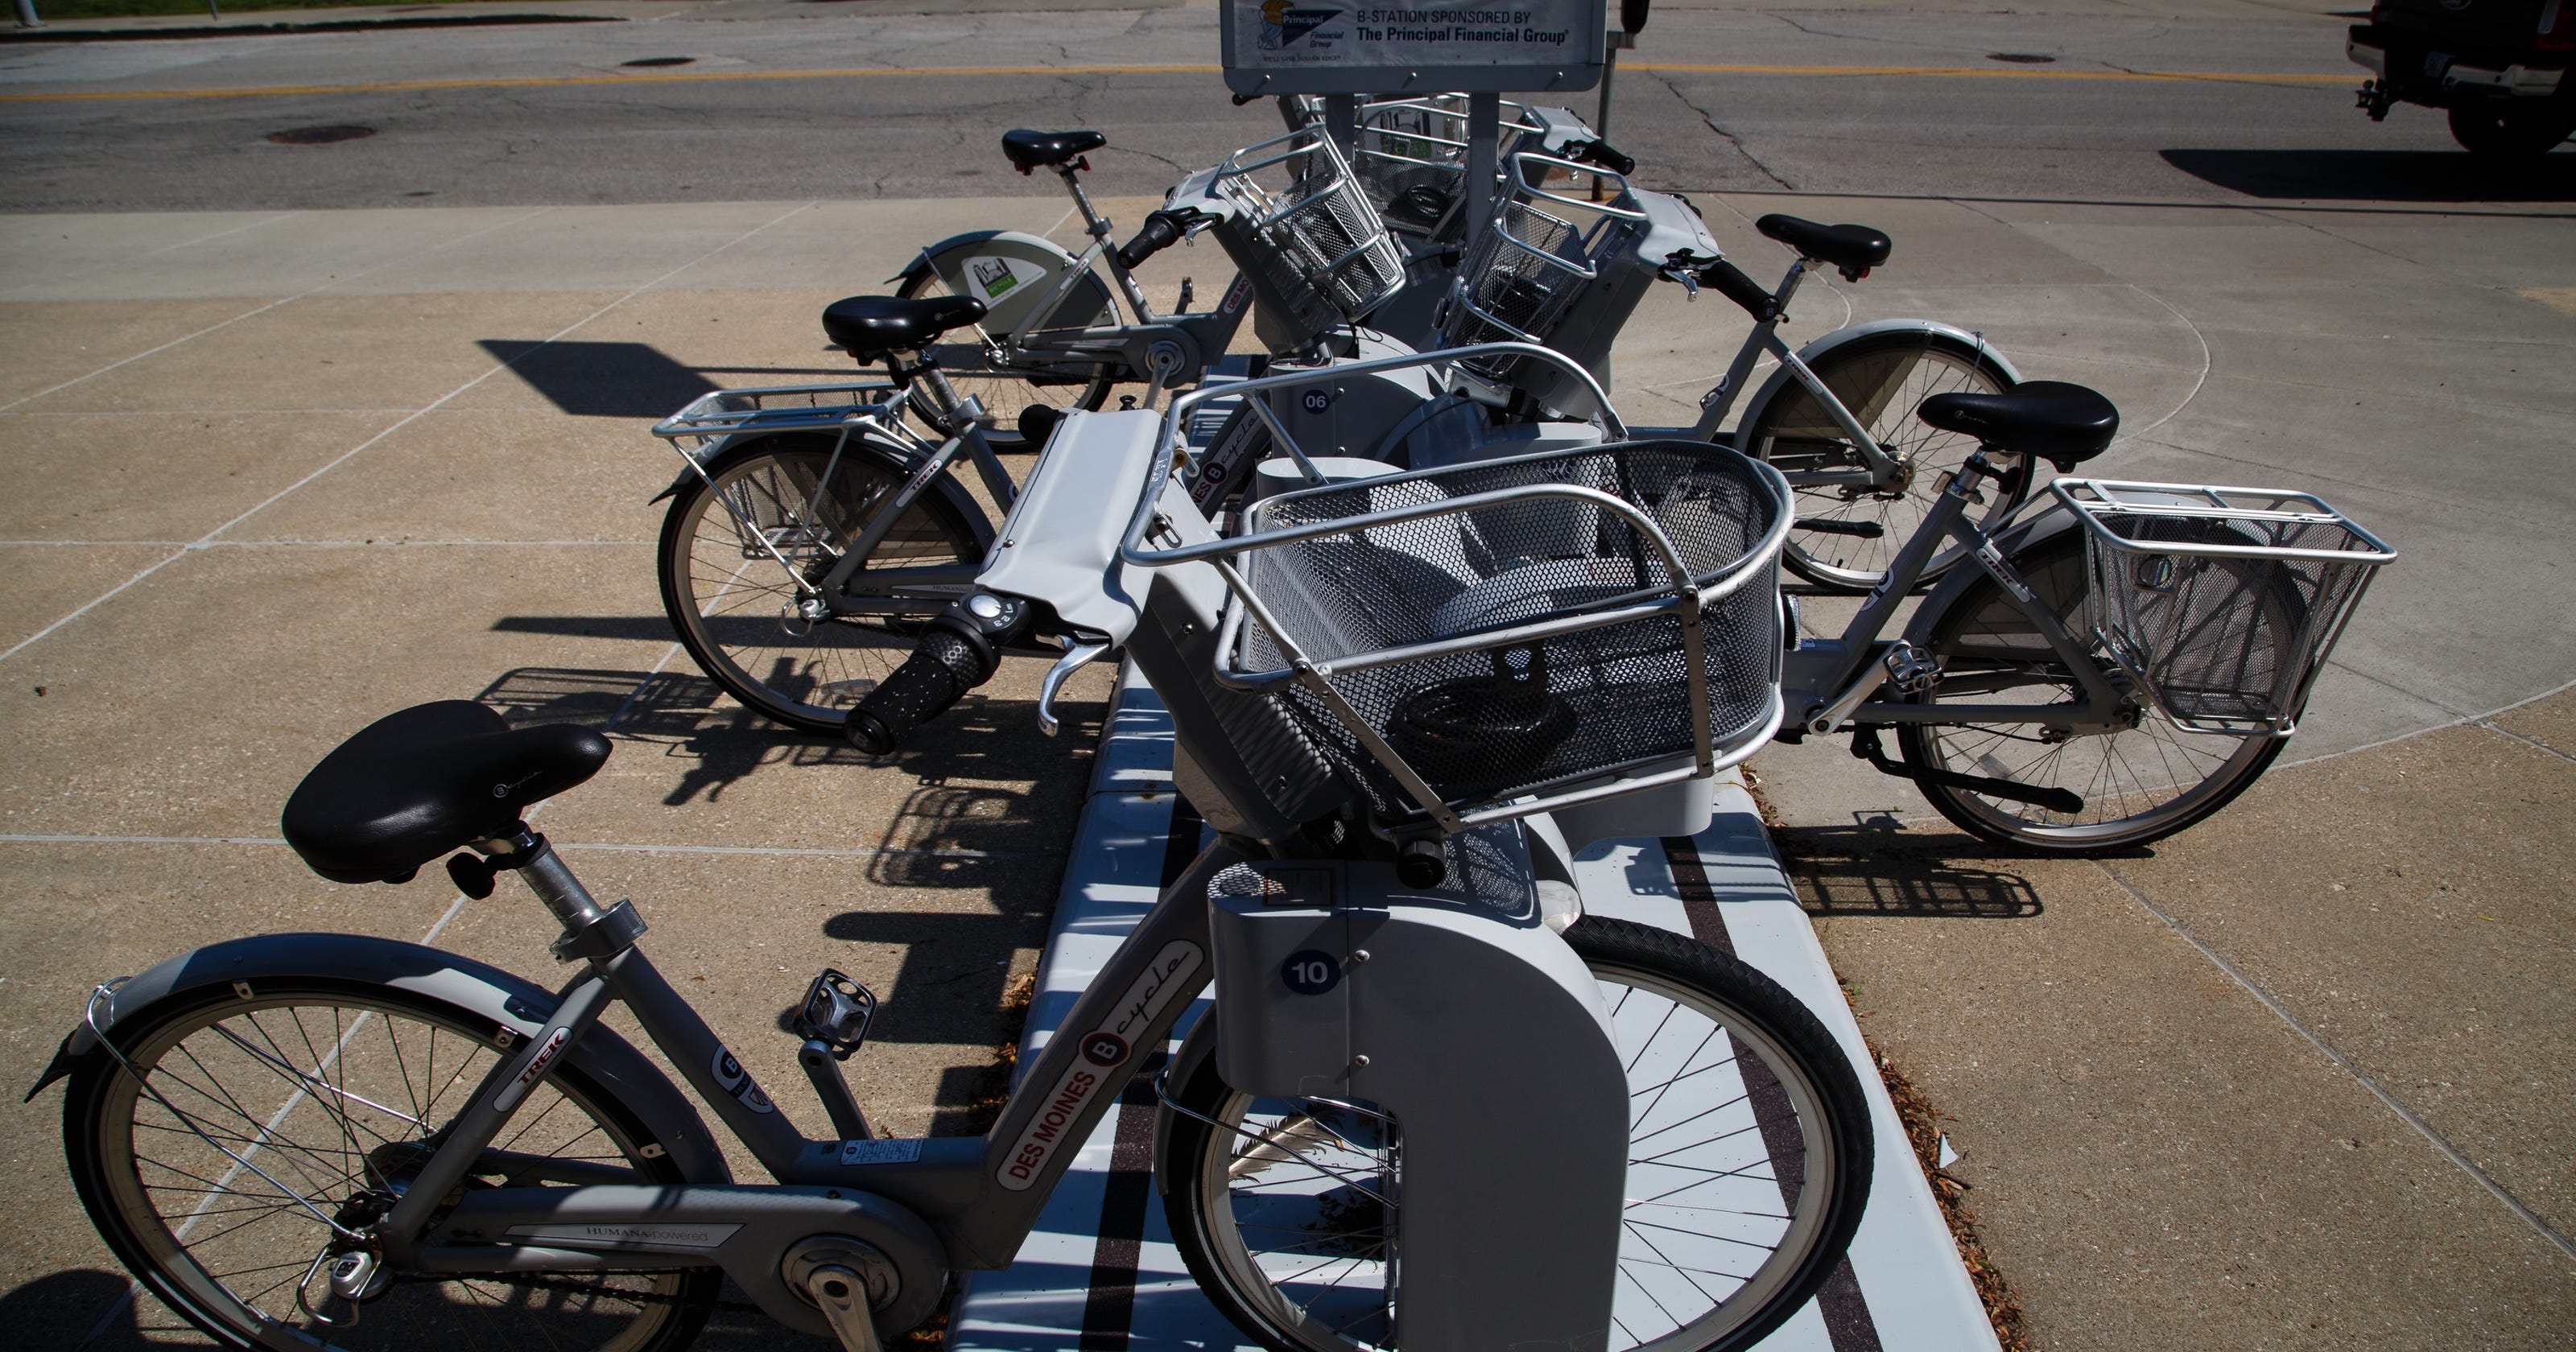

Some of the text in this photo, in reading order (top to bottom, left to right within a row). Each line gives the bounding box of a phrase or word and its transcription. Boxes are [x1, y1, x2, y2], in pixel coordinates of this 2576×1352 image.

[1282, 14, 1323, 25] Principal
[1356, 10, 1531, 24] B-STATION SPONSORED BY
[1310, 31, 1344, 39] Financial
[1356, 27, 1383, 41] The
[1387, 27, 1450, 43] Principal
[1454, 28, 1519, 43] Financial
[1310, 39, 1332, 49] Group
[1227, 293, 1241, 310] DES
[1305, 395, 1327, 409] 06
[910, 464, 938, 491] TREK
[1982, 551, 2015, 585] TREK
[1291, 961, 1329, 985] 10
[516, 1033, 565, 1085] TREK
[1009, 1143, 1046, 1181] DES
[1038, 1071, 1096, 1144] MOINES
[1117, 950, 1190, 1035] cycle
